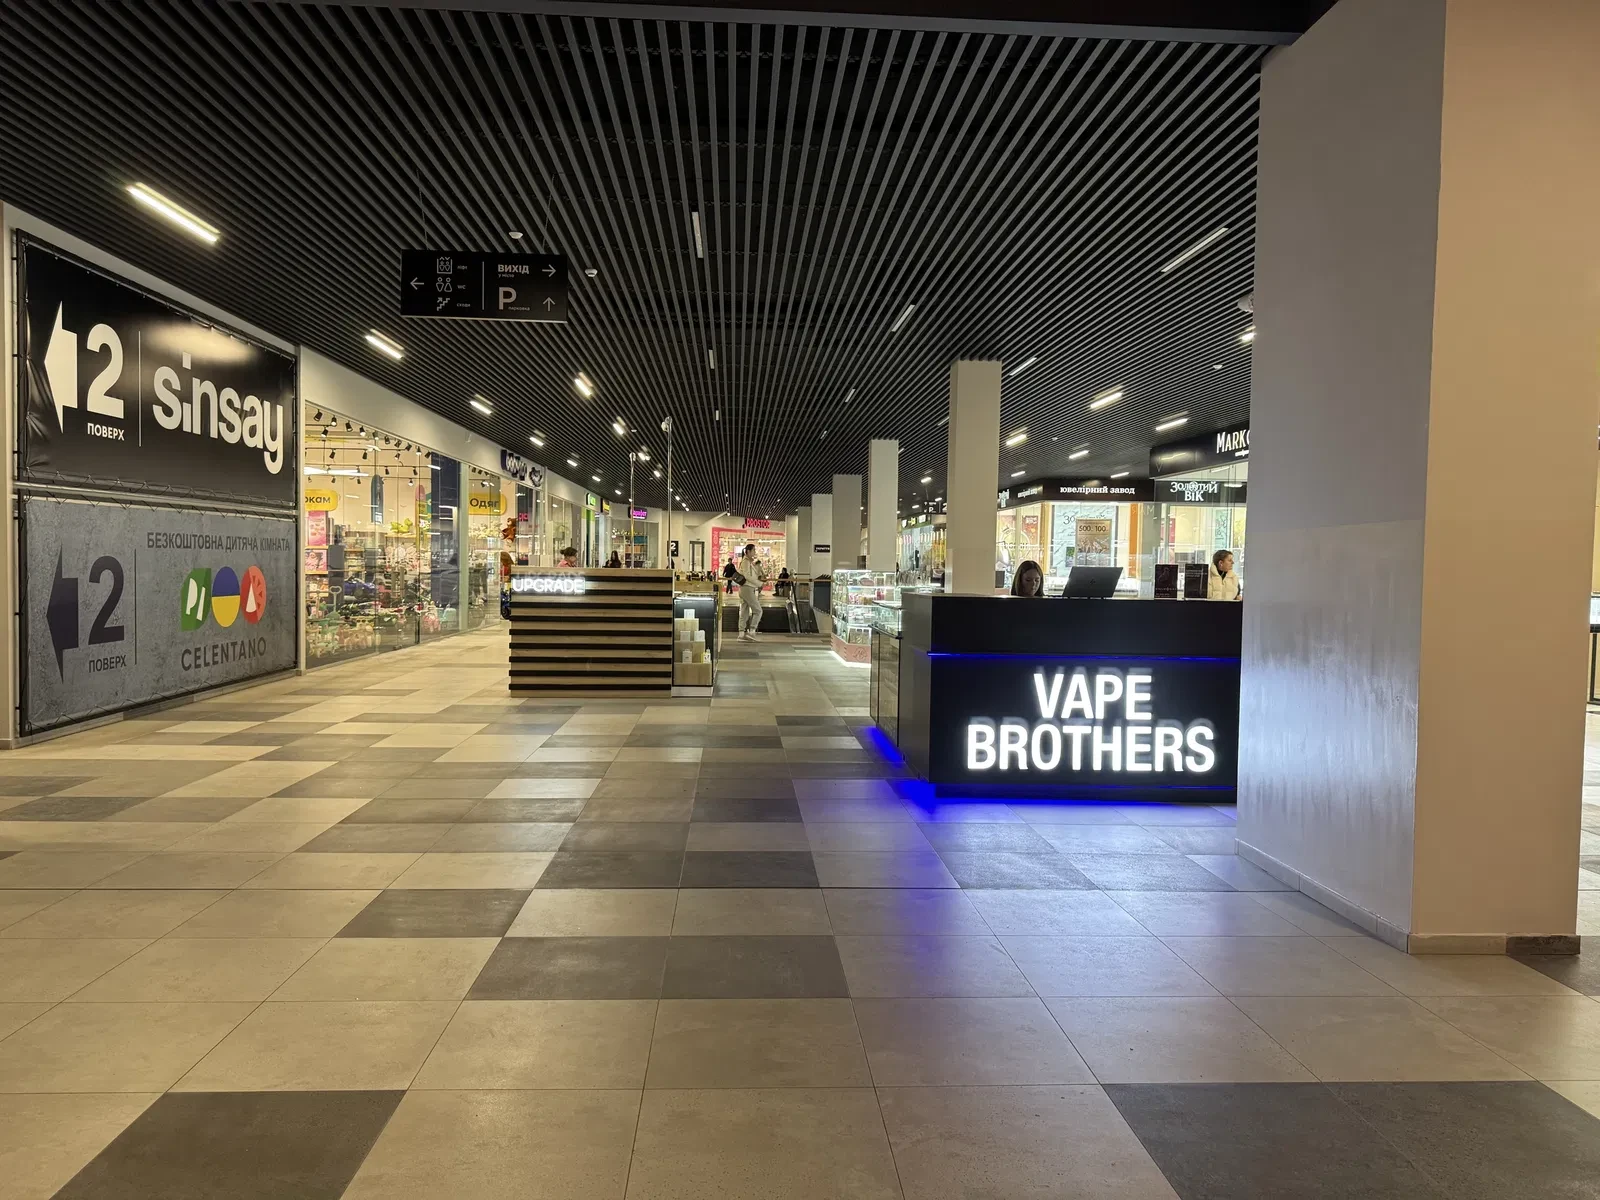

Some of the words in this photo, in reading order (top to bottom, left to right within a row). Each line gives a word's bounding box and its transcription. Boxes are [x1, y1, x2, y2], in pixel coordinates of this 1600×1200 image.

[497, 264, 530, 274] ВИХІД
[498, 287, 517, 310] P
[87, 323, 124, 419] 2
[152, 352, 284, 474] sinsay
[87, 422, 125, 441] ПОВЕРХ
[1060, 485, 1108, 494] ювелірний
[470, 498, 499, 508] Одяг
[147, 532, 224, 550] БЕЗКОШТОВНА
[225, 536, 259, 552] ДИТЯЧА
[259, 537, 290, 551] КІМНАТА
[512, 578, 585, 593] UPGRADE
[88, 556, 125, 645] 2
[89, 655, 127, 673] ПОВЕРХ
[181, 637, 267, 671] CELENTANO
[1033, 673, 1152, 720] VAPE
[967, 724, 1215, 772] BROTHERS
